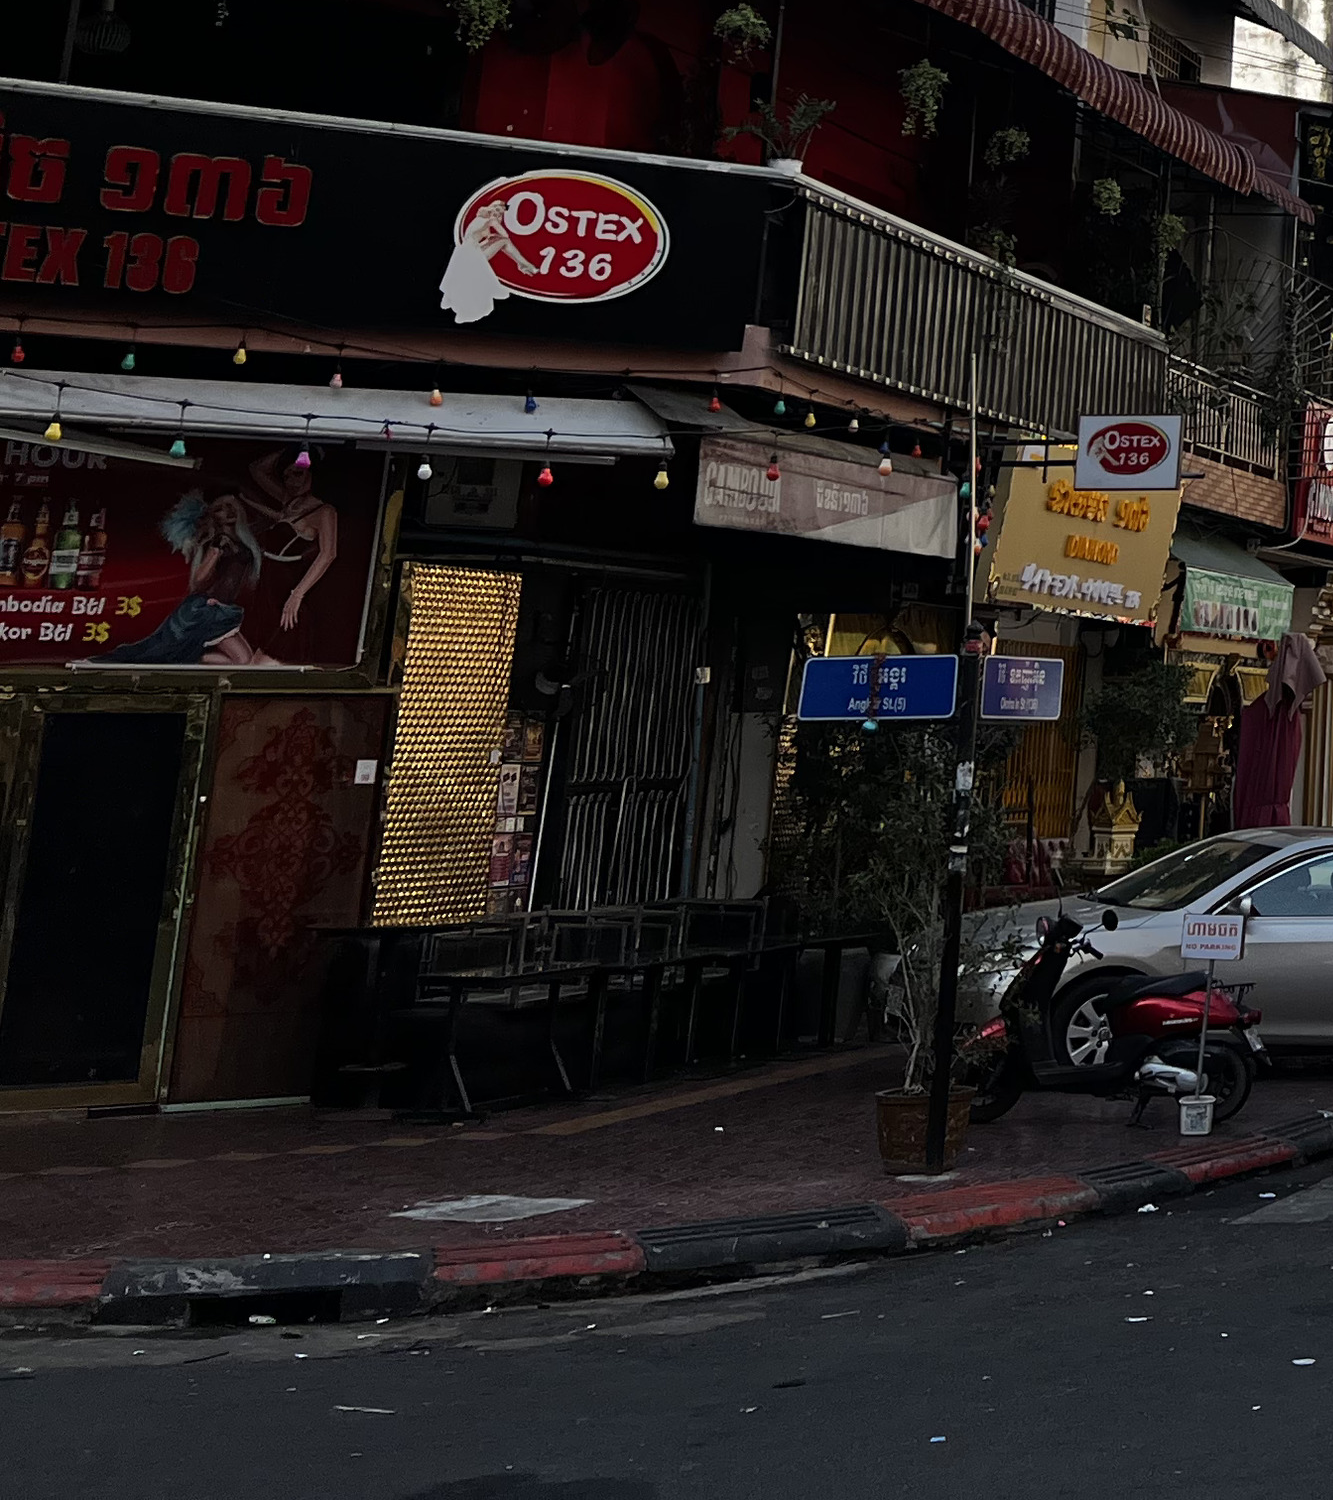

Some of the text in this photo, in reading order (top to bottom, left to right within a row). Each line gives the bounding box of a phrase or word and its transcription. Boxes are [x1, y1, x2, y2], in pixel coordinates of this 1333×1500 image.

[103, 230, 200, 295] 136
[539, 245, 612, 282] 136
[1118, 452, 1150, 466] 136
[115, 595, 143, 618] 3$
[82, 621, 111, 645] 3$
[1200, 943, 1237, 951] PARKING
